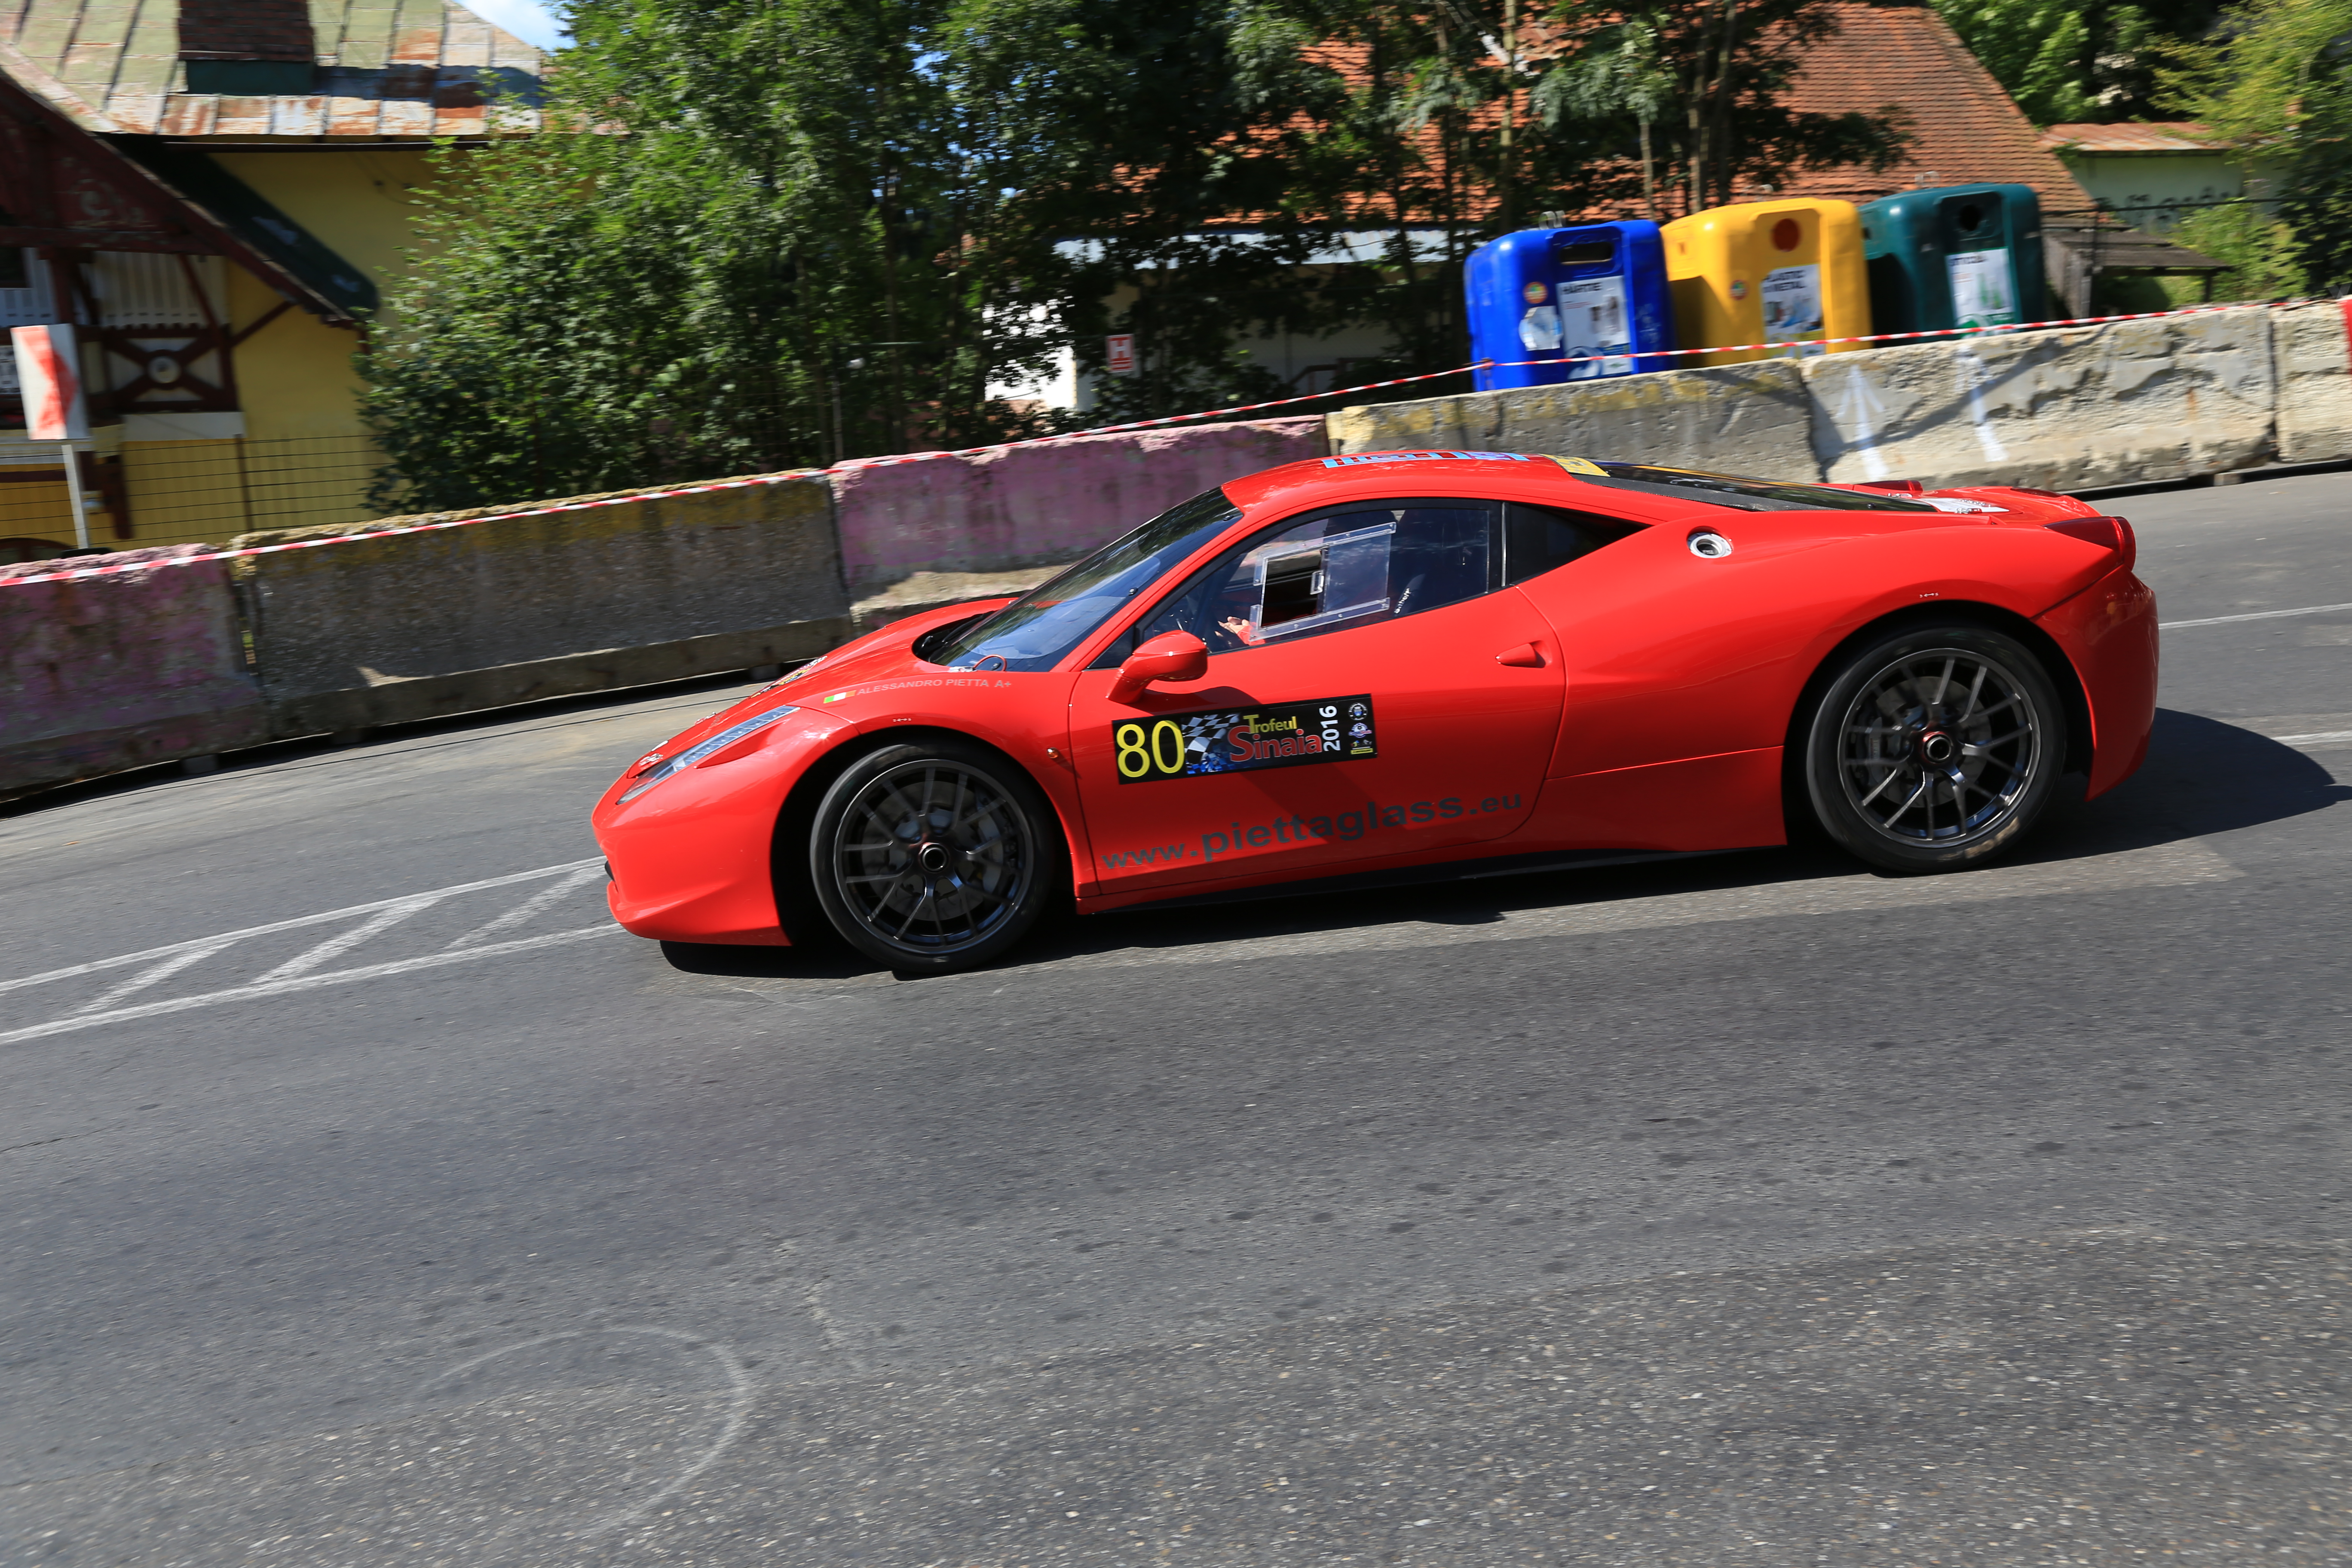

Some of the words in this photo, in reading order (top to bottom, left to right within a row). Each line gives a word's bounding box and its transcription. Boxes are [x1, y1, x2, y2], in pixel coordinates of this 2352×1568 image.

[1110, 339, 1130, 359] H
[856, 680, 943, 695] ALESSANDRO
[945, 679, 989, 687] PIETTA
[1243, 714, 1298, 734] Trofeul
[1319, 705, 1341, 751] 2016
[1116, 720, 1185, 778] 80
[1228, 725, 1323, 762] Sinaia
[1102, 793, 1522, 870] www.piettaglass.eu
